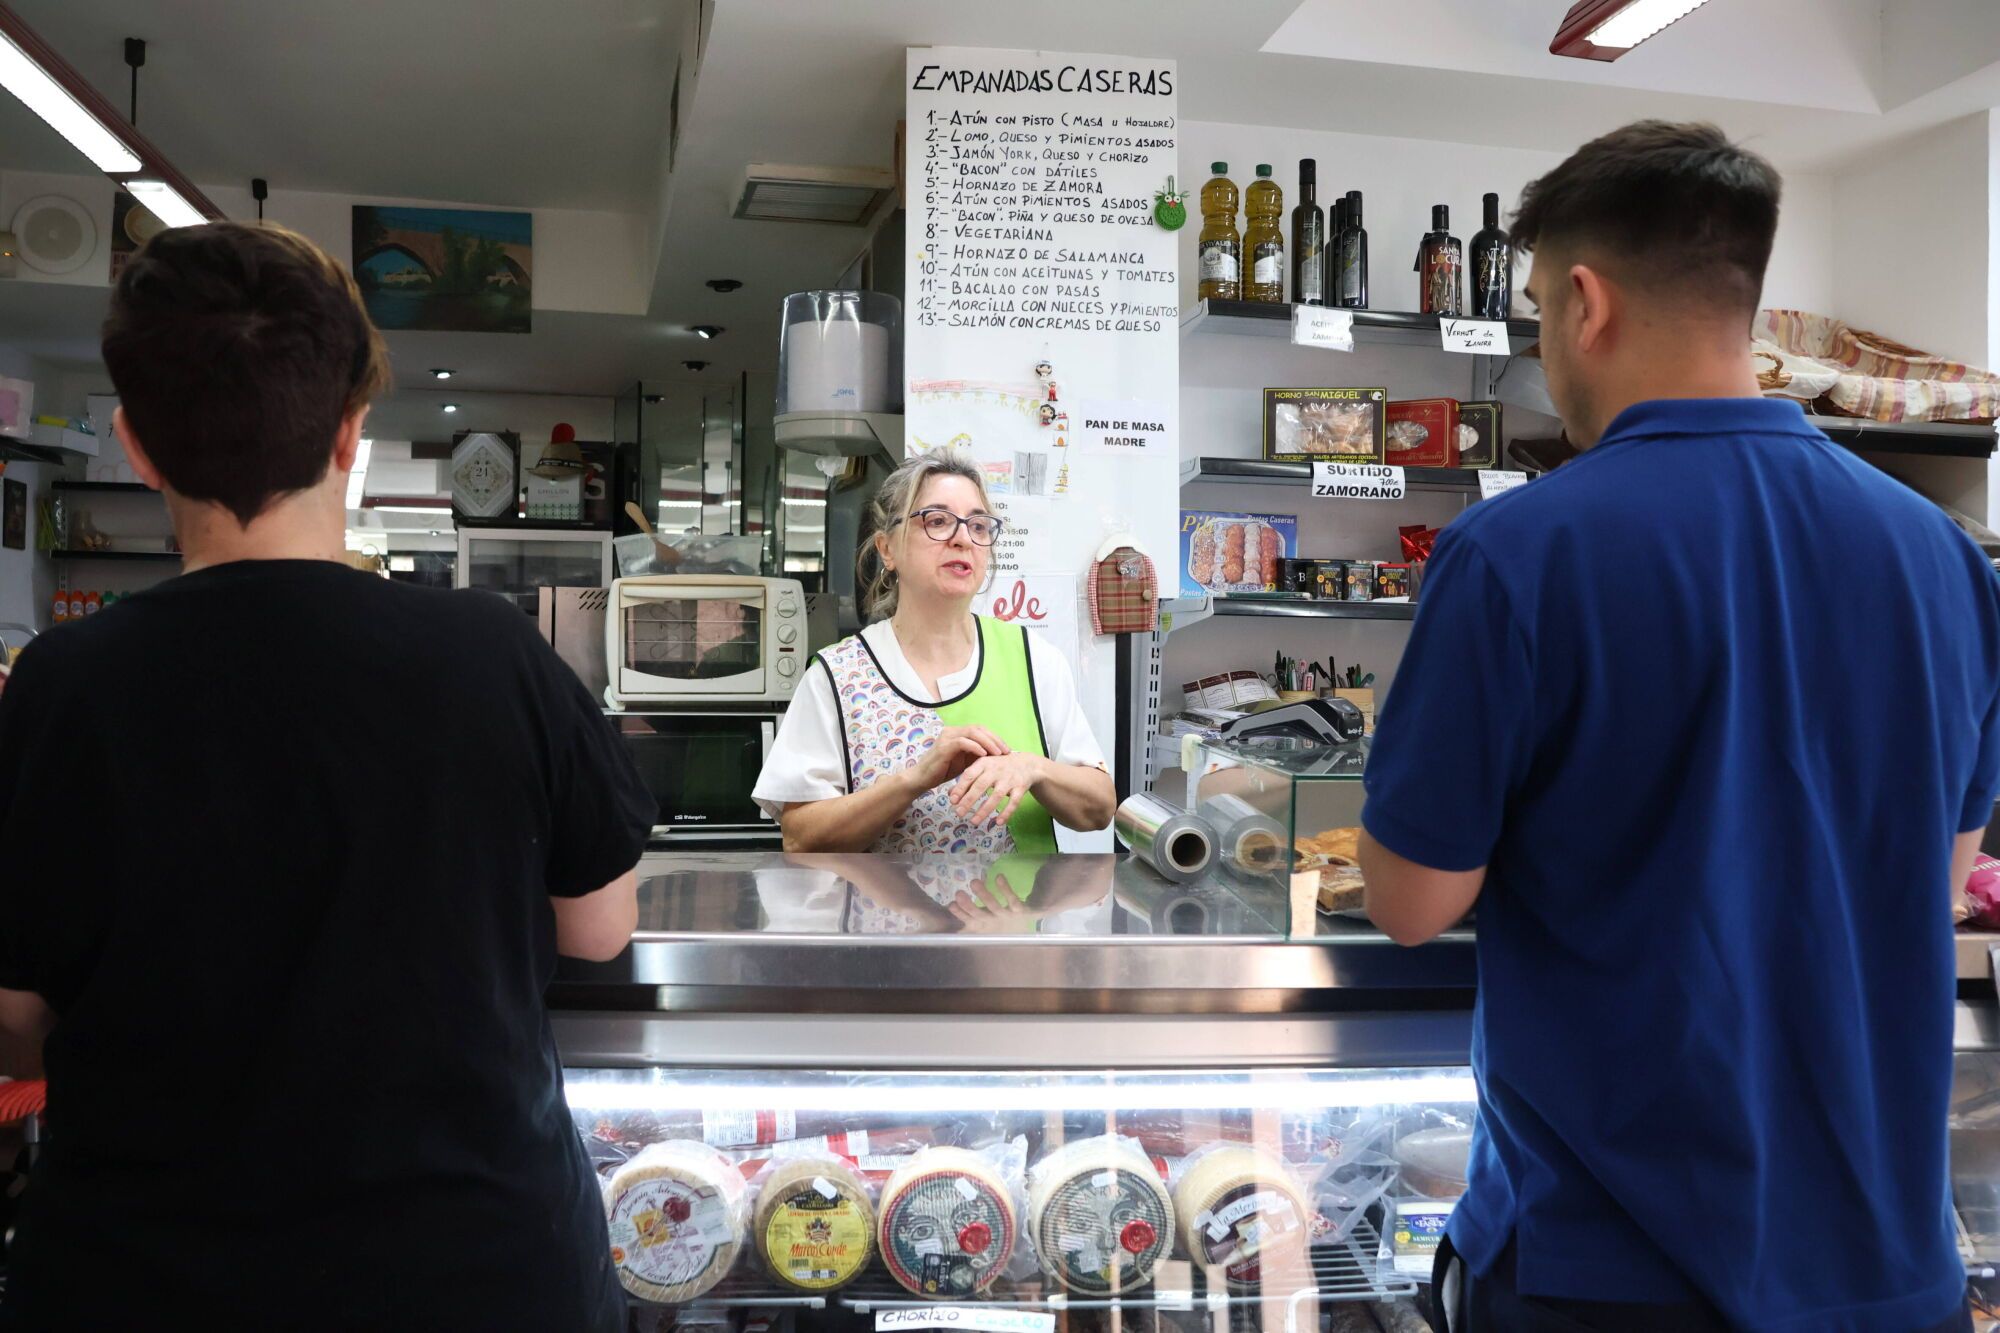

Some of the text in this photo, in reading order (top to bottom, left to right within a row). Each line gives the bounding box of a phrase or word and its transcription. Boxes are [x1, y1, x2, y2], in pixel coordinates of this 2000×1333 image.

[912, 66, 1173, 96] EMPANADAS CASERAS
[950, 110, 987, 125] ATÚN
[996, 116, 1016, 124] CON
[1022, 115, 1054, 126] PISTO
[950, 129, 994, 143] LOMO,
[999, 132, 1037, 142] QUESO
[1059, 133, 1132, 146] PIMIENTOS
[1135, 139, 1174, 148] ASADOS
[950, 144, 994, 159] JAMÓN
[1000, 146, 1038, 161] YORK,
[1042, 148, 1080, 160] QUESO
[1099, 152, 1148, 163] CHORIZO
[1012, 166, 1036, 176] CON
[1046, 162, 1098, 178] DÁTILES
[953, 177, 1016, 191] HORNAZO
[1023, 182, 1038, 191] DE
[1044, 180, 1103, 194] ZAMORA
[952, 192, 987, 205] ATÚN
[994, 196, 1016, 205] CON
[1022, 194, 1090, 208] PIMIENTOS
[1102, 198, 1148, 210] ASADOS
[1008, 210, 1033, 222] PIÑA
[1054, 213, 1094, 223] QUESO
[1101, 214, 1114, 223] DE
[1118, 216, 1153, 226] OVEJA
[955, 224, 1053, 240] VEGETARIANA
[954, 244, 1028, 260] HORNAZO
[1034, 250, 1049, 260] DE
[1055, 249, 1144, 264] SALAMANCA
[950, 263, 988, 277] ATÚN
[994, 268, 1016, 278] CON
[1022, 266, 1094, 280] ACEITUNAS
[1102, 270, 1108, 280] Y
[1117, 270, 1174, 283] TOMATES
[952, 281, 1015, 294] BACALAO
[1022, 285, 1048, 295] CON
[1057, 285, 1100, 298] PASAS
[948, 298, 1014, 312] MORCILLA
[1022, 300, 1046, 312] CON
[1051, 300, 1104, 314] NUECES
[948, 314, 1005, 327] SALMÓN
[1096, 320, 1111, 330] DE
[1116, 320, 1160, 332] QUESO
[1320, 391, 1360, 399] MIGUEL
[1086, 420, 1164, 432] PAN DE MASA
[1104, 436, 1146, 446] MADRE
[1328, 465, 1392, 478] SURTIDO
[1316, 485, 1402, 498] ZAMORANO
[882, 1310, 960, 1322] CHORIZO
